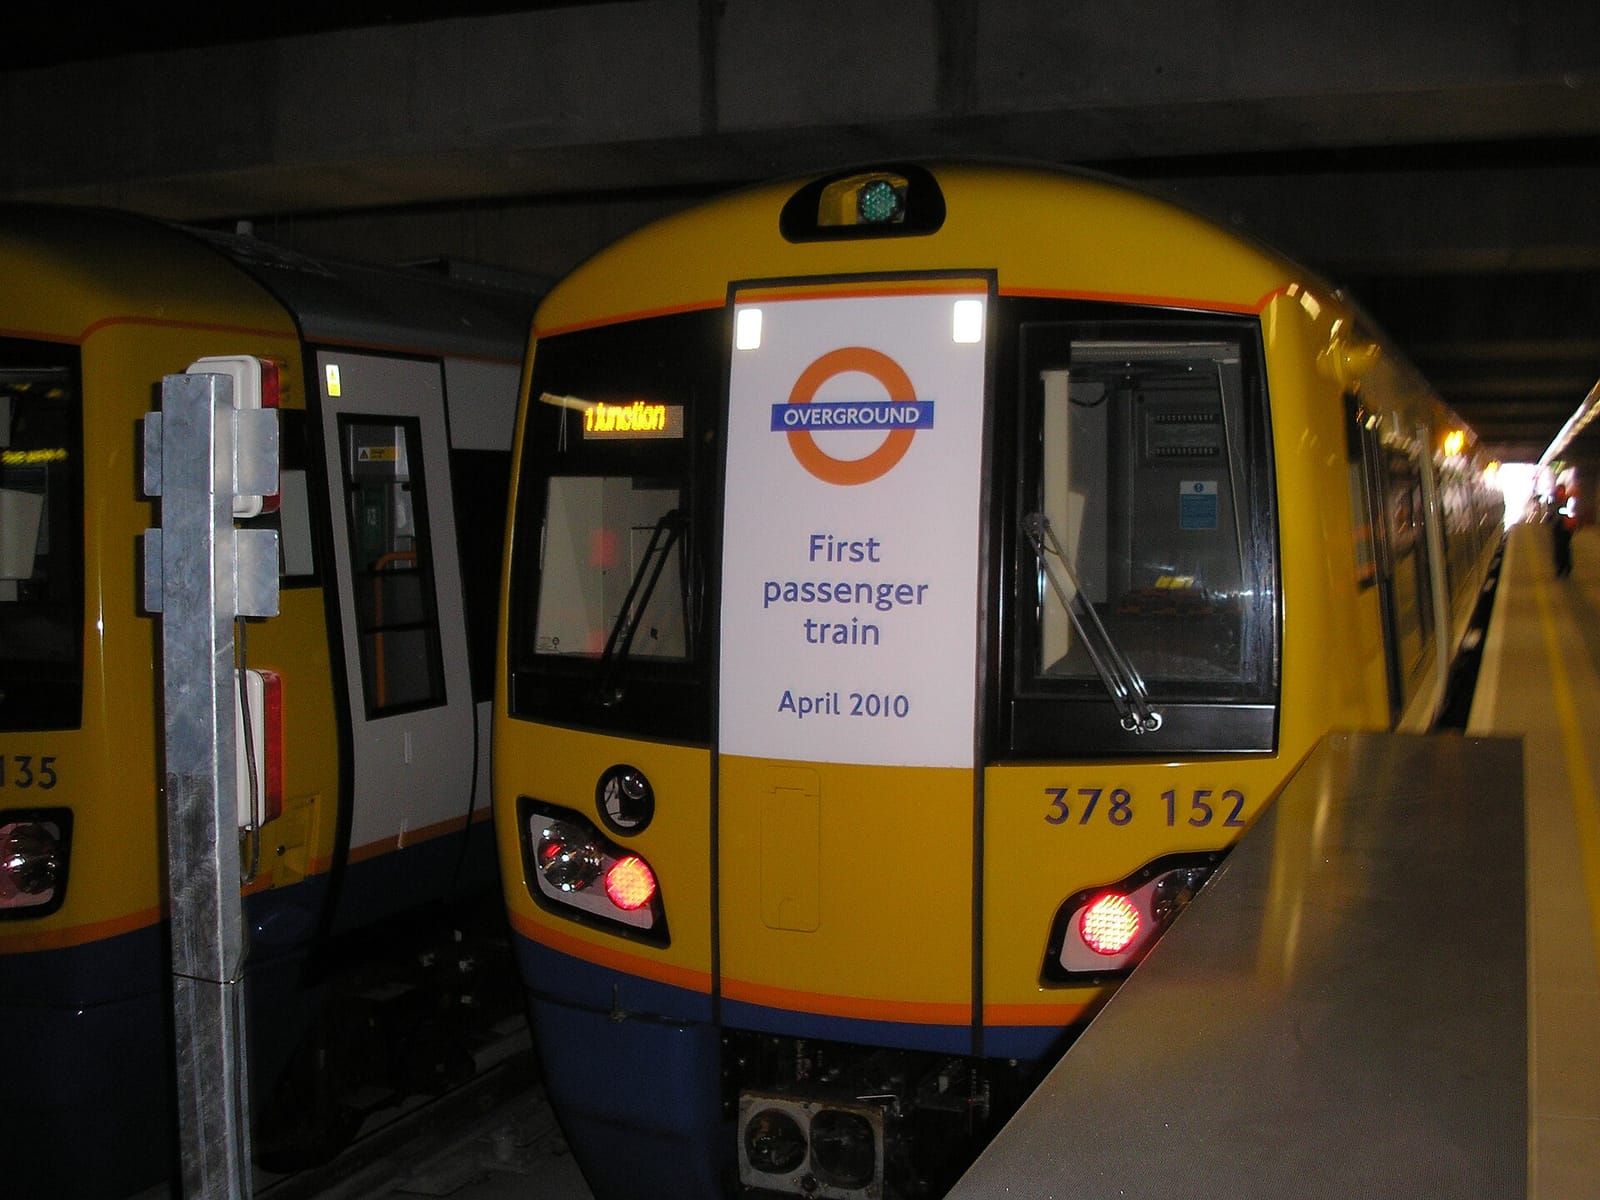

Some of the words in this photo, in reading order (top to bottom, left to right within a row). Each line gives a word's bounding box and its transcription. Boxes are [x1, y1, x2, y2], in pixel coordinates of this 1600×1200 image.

[783, 405, 920, 426] OVERGROUND
[809, 534, 881, 563] First
[763, 580, 929, 612] passenger
[804, 616, 880, 646] train
[777, 690, 841, 719] April
[849, 692, 910, 718] 2010
[1044, 787, 1133, 827] 378
[1160, 789, 1246, 828] 152
